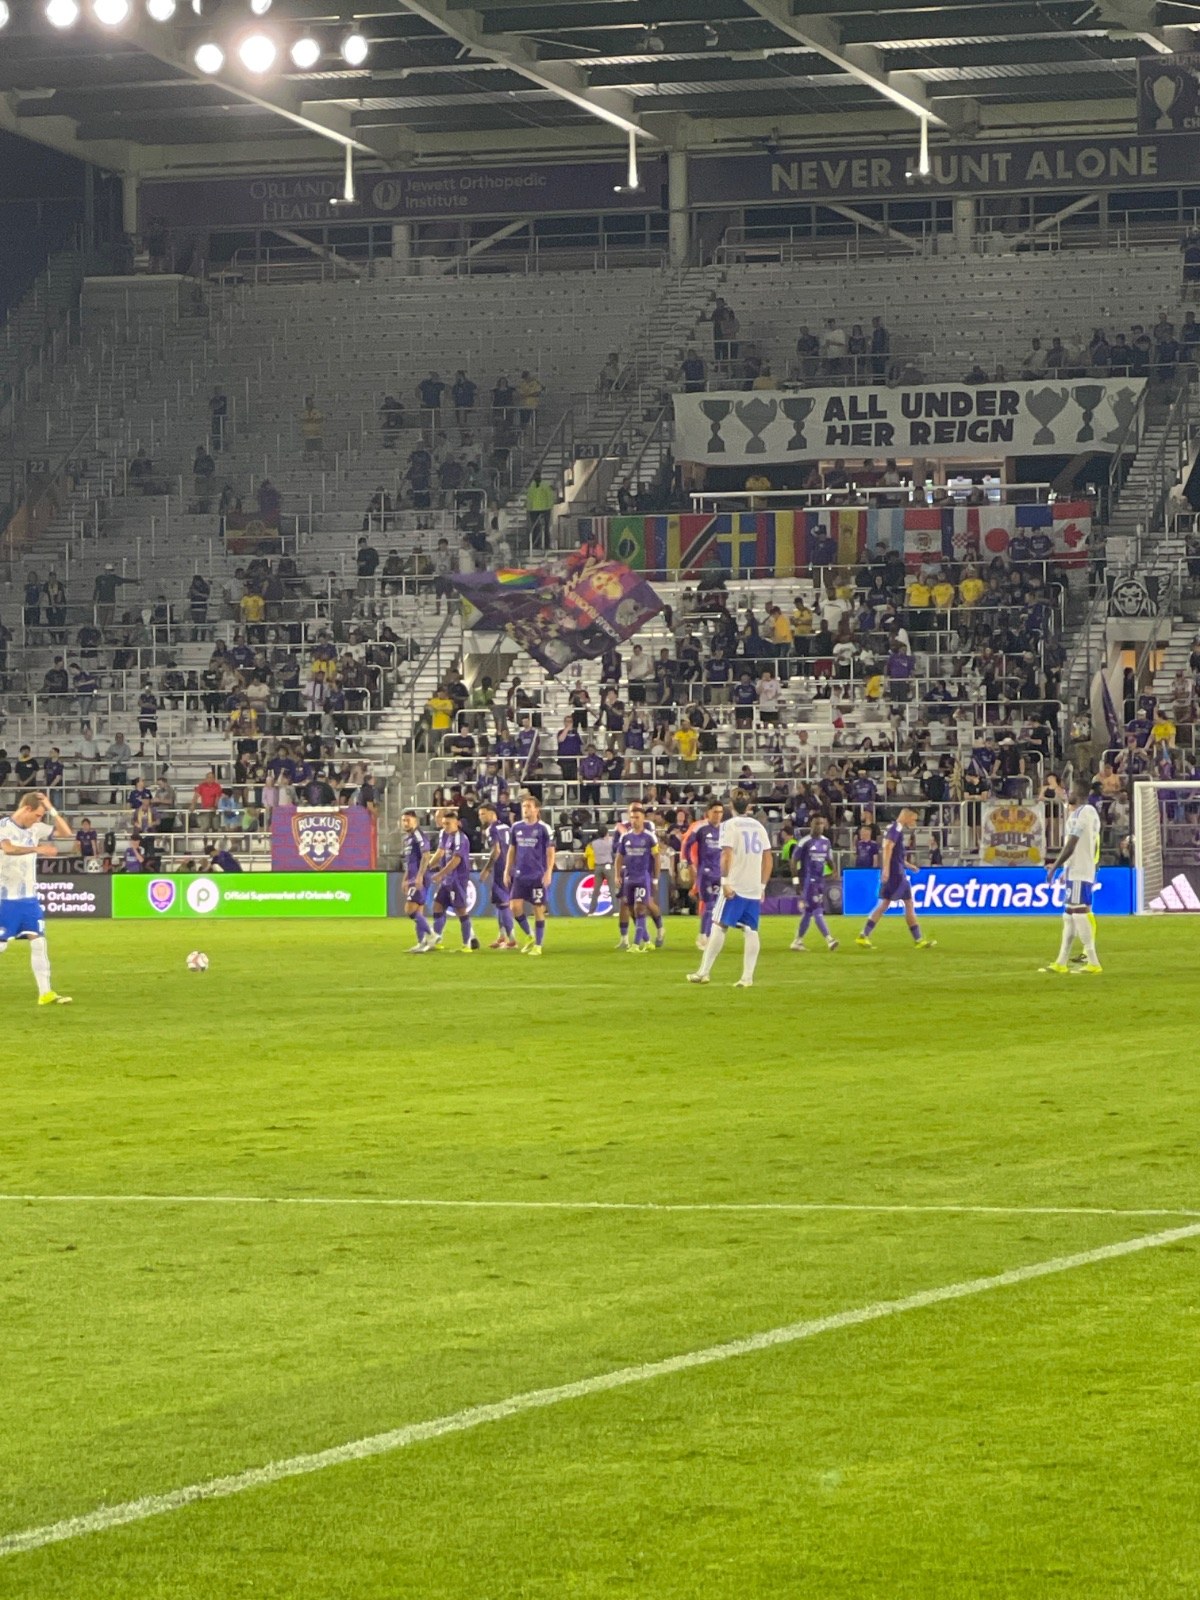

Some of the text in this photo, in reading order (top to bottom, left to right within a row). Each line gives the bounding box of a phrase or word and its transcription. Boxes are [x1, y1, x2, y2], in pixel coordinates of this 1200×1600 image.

[770, 157, 893, 193] NEVER
[1025, 145, 1158, 181] ALONE
[405, 172, 547, 193] Jewett Orthopedic
[405, 194, 469, 209] Institute
[823, 389, 1021, 423] ALL UNDER
[825, 418, 1015, 447] HER REIGN
[298, 816, 343, 832] RUCKUS
[742, 830, 762, 854] 16
[990, 832, 1035, 848] BUILT
[47, 891, 95, 900] Orlando
[224, 890, 351, 902] Official Supermarket of Orlando City
[532, 888, 543, 898] 13
[635, 887, 646, 897] 10
[47, 902, 96, 912] Orlando
